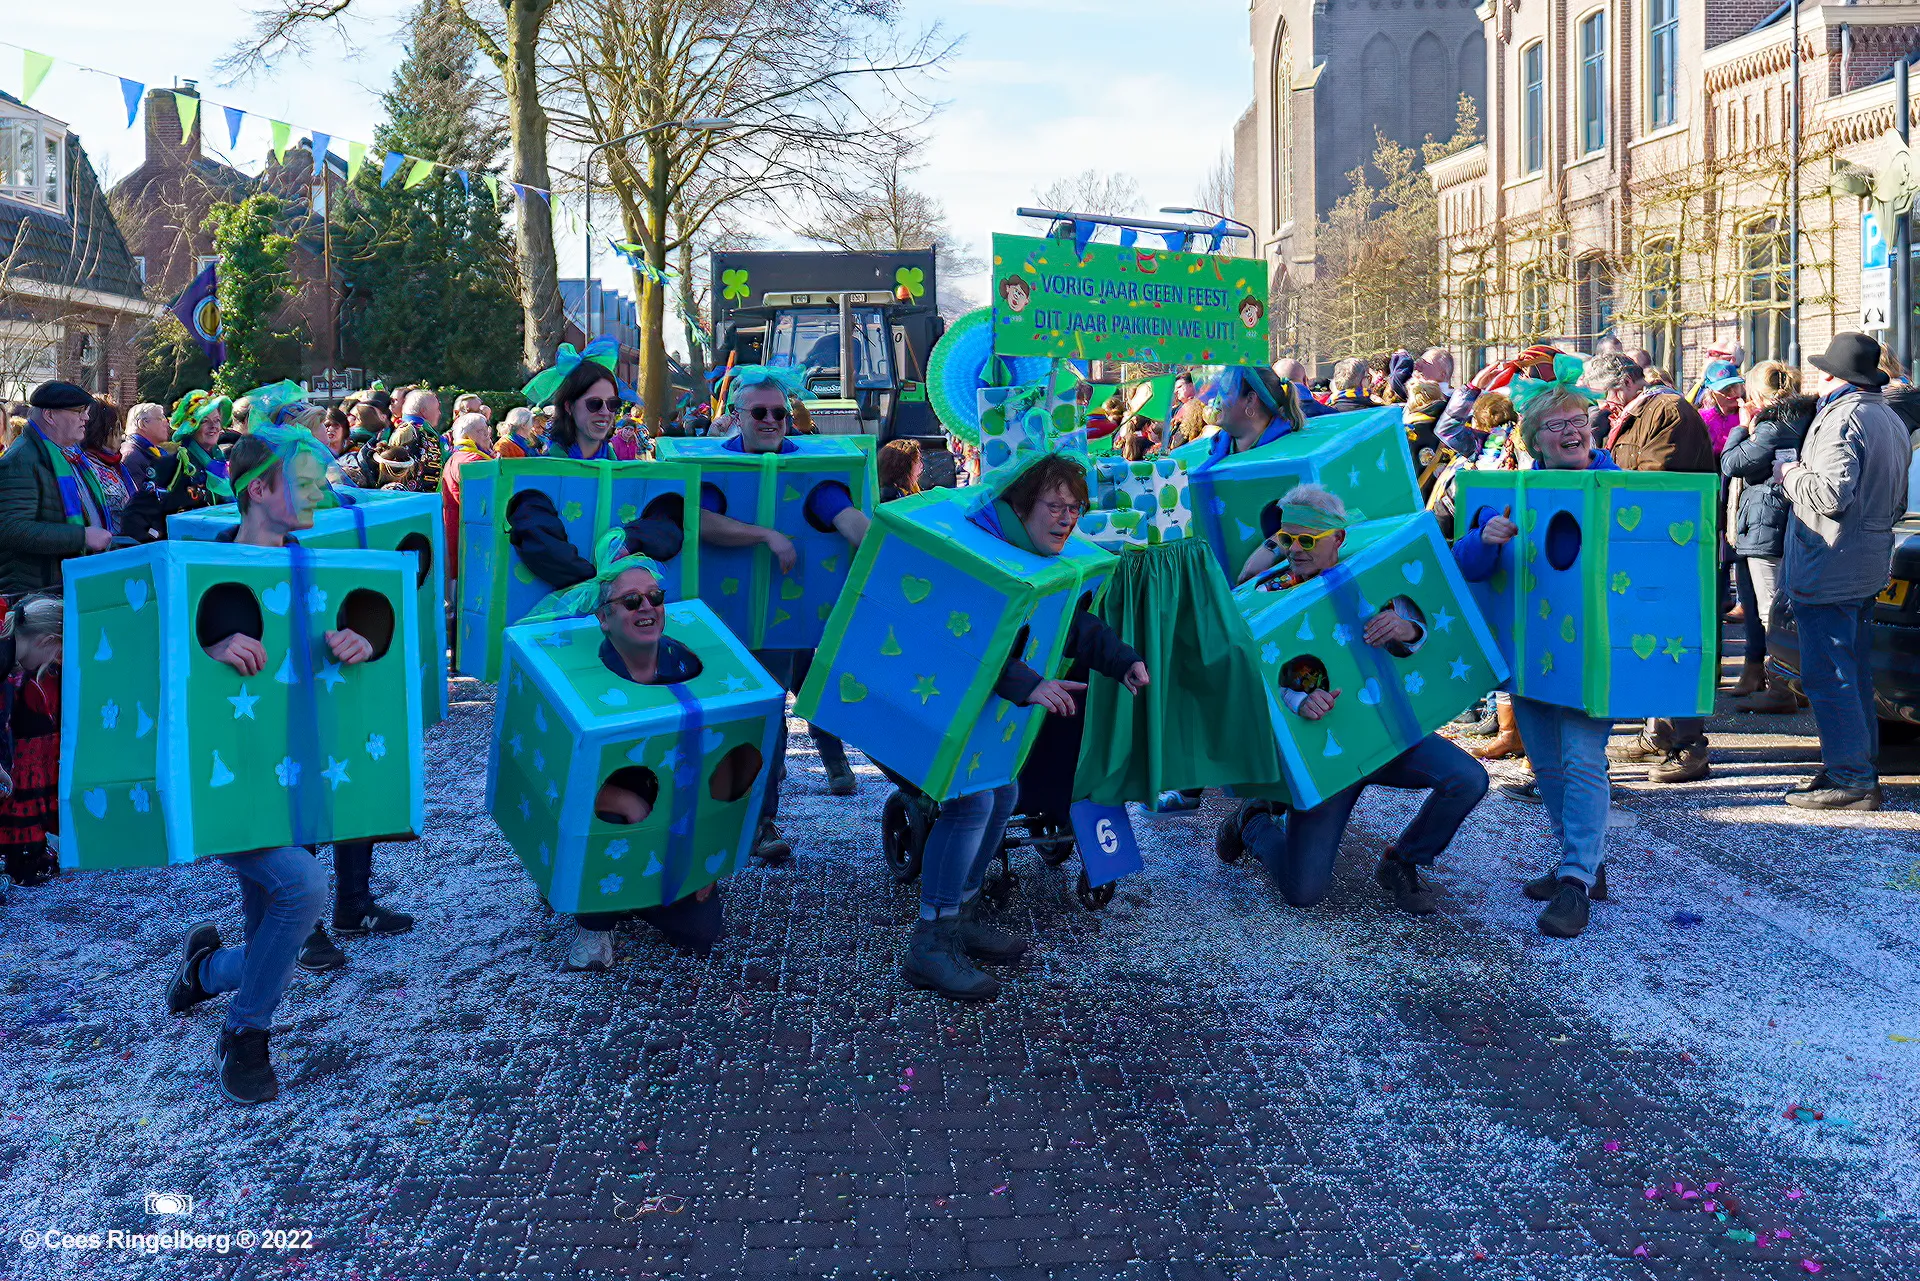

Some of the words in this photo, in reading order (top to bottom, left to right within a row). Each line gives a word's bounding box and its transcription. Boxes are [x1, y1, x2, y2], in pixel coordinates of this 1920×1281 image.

[1865, 217, 1881, 264] P
[1041, 273, 1094, 297] VORIG
[1098, 278, 1138, 300] JAAR
[1142, 282, 1183, 304] GEEN
[1187, 288, 1230, 311] FEEST,
[1034, 309, 1063, 330] DIT
[1065, 312, 1107, 334] JAAR
[1111, 316, 1173, 337] PAKKEN
[1177, 320, 1201, 339] WE
[1205, 321, 1236, 341] UIT!
[1096, 818, 1118, 854] 6
